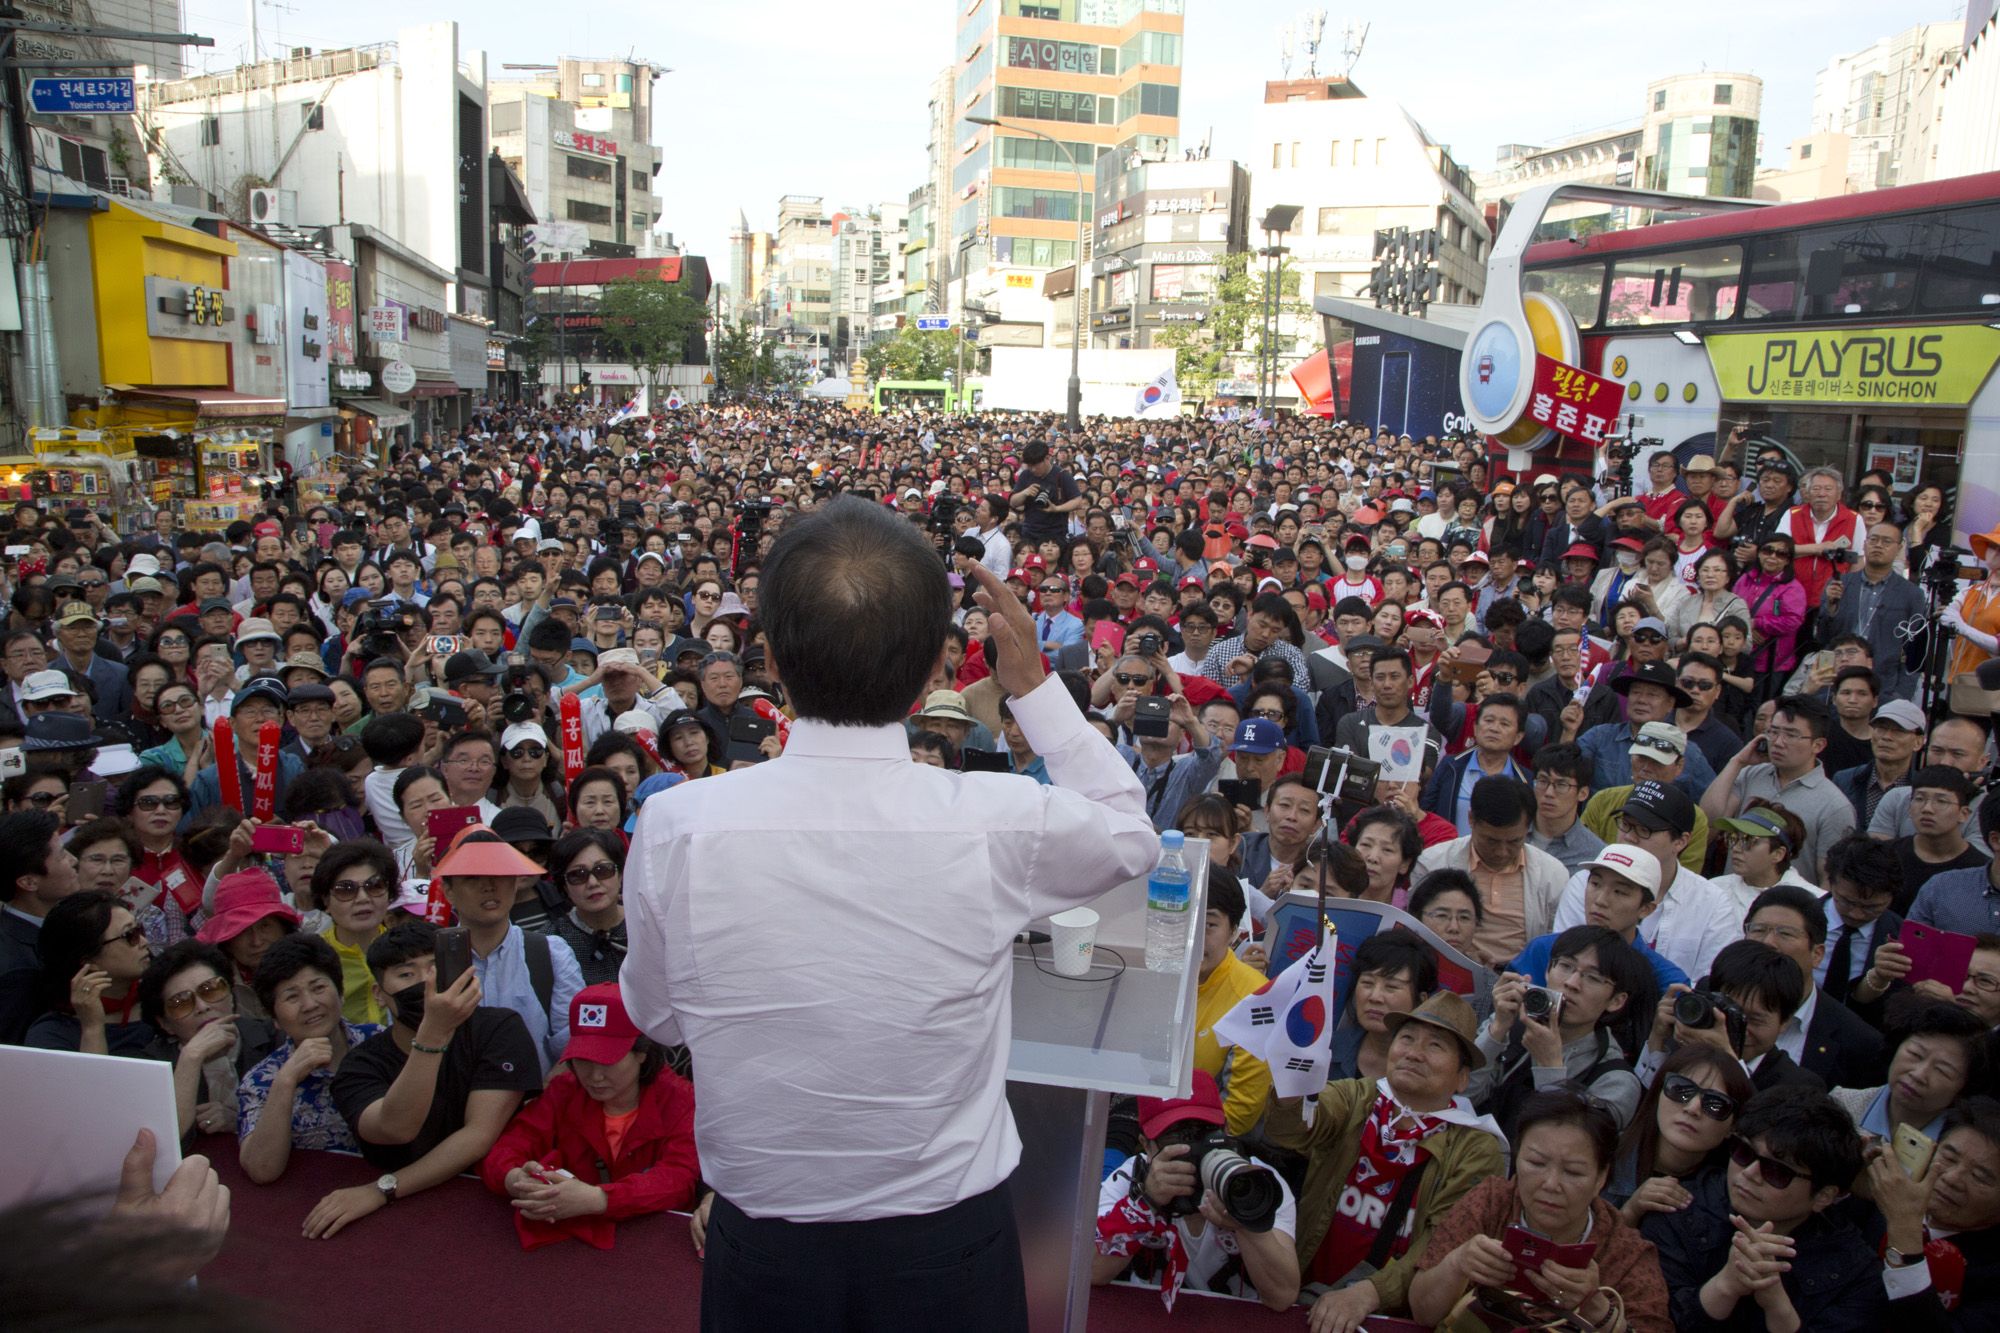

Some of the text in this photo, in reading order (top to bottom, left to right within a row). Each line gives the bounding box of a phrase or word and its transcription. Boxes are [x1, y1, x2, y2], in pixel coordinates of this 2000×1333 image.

[1062, 49, 1098, 72] 헌혈
[60, 81, 131, 98] 연세로5가길
[69, 100, 133, 111] Yonsei-ro 5ga-gil
[1152, 251, 1176, 262] Mari
[1008, 275, 1032, 284] 부동산
[373, 310, 396, 321] 함흥
[564, 315, 590, 327] CAFFÉ
[373, 322, 396, 332] 냉면
[1355, 335, 1380, 346] SAMSUNG
[1552, 366, 1600, 402] 필승!
[1769, 379, 1937, 398] 신촌플레이버스 SINCHON
[1532, 392, 1607, 443] 홍준표
[1244, 724, 1257, 741] LA
[1641, 786, 1665, 800] MACHINA
[1605, 853, 1631, 865] Supreme
